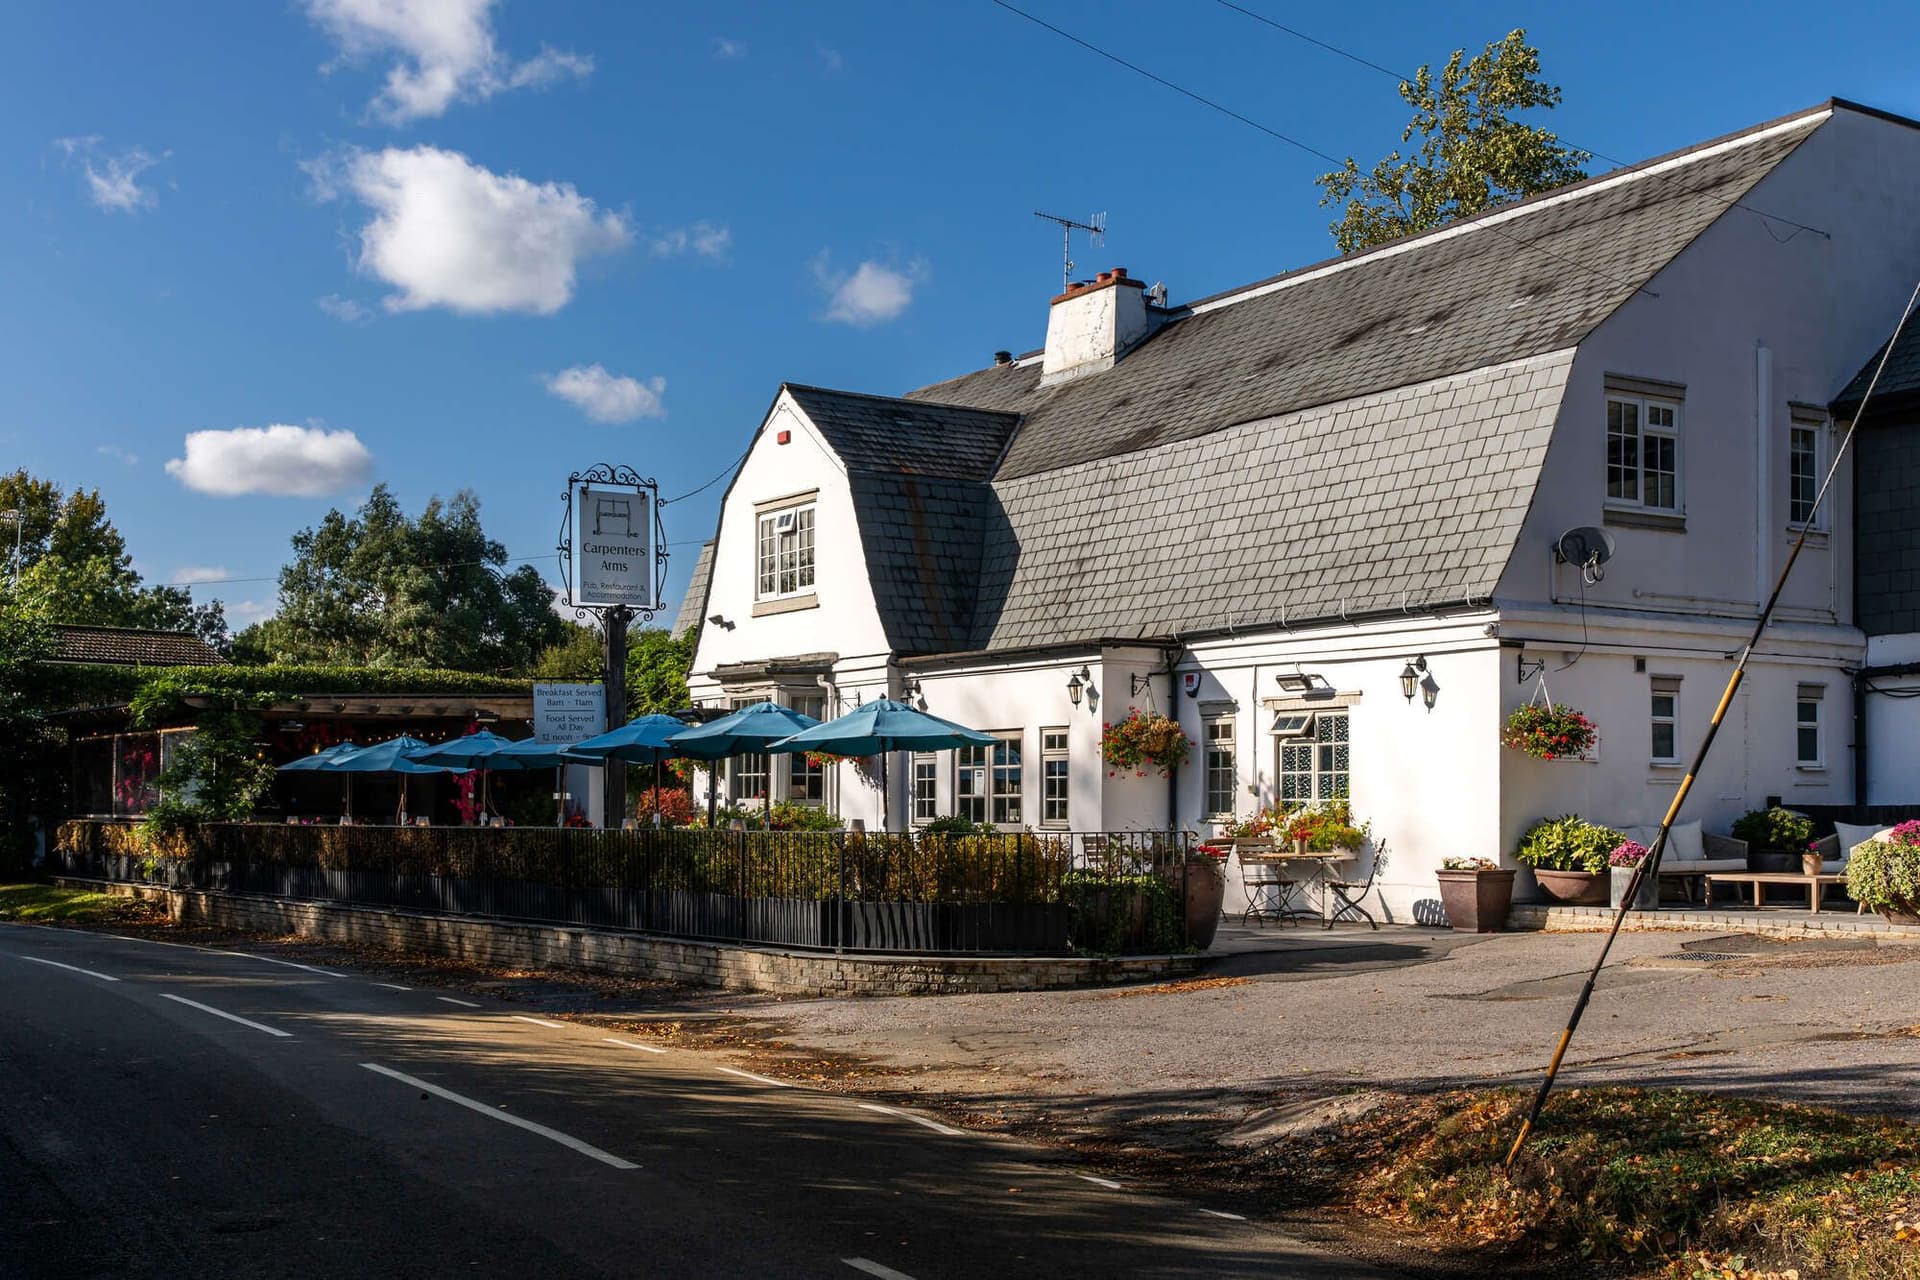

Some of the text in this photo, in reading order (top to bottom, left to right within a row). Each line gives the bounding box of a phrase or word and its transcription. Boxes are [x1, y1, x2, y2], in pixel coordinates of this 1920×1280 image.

[583, 542, 646, 557] Carpenters
[601, 560, 628, 572] Arms
[600, 581, 638, 592] Restaurant
[587, 591, 642, 600] Accommodation
[536, 688, 602, 697] Breakfast Served
[546, 714, 594, 723] Food Served
[556, 723, 584, 732] All Day
[542, 733, 550, 741] 12
